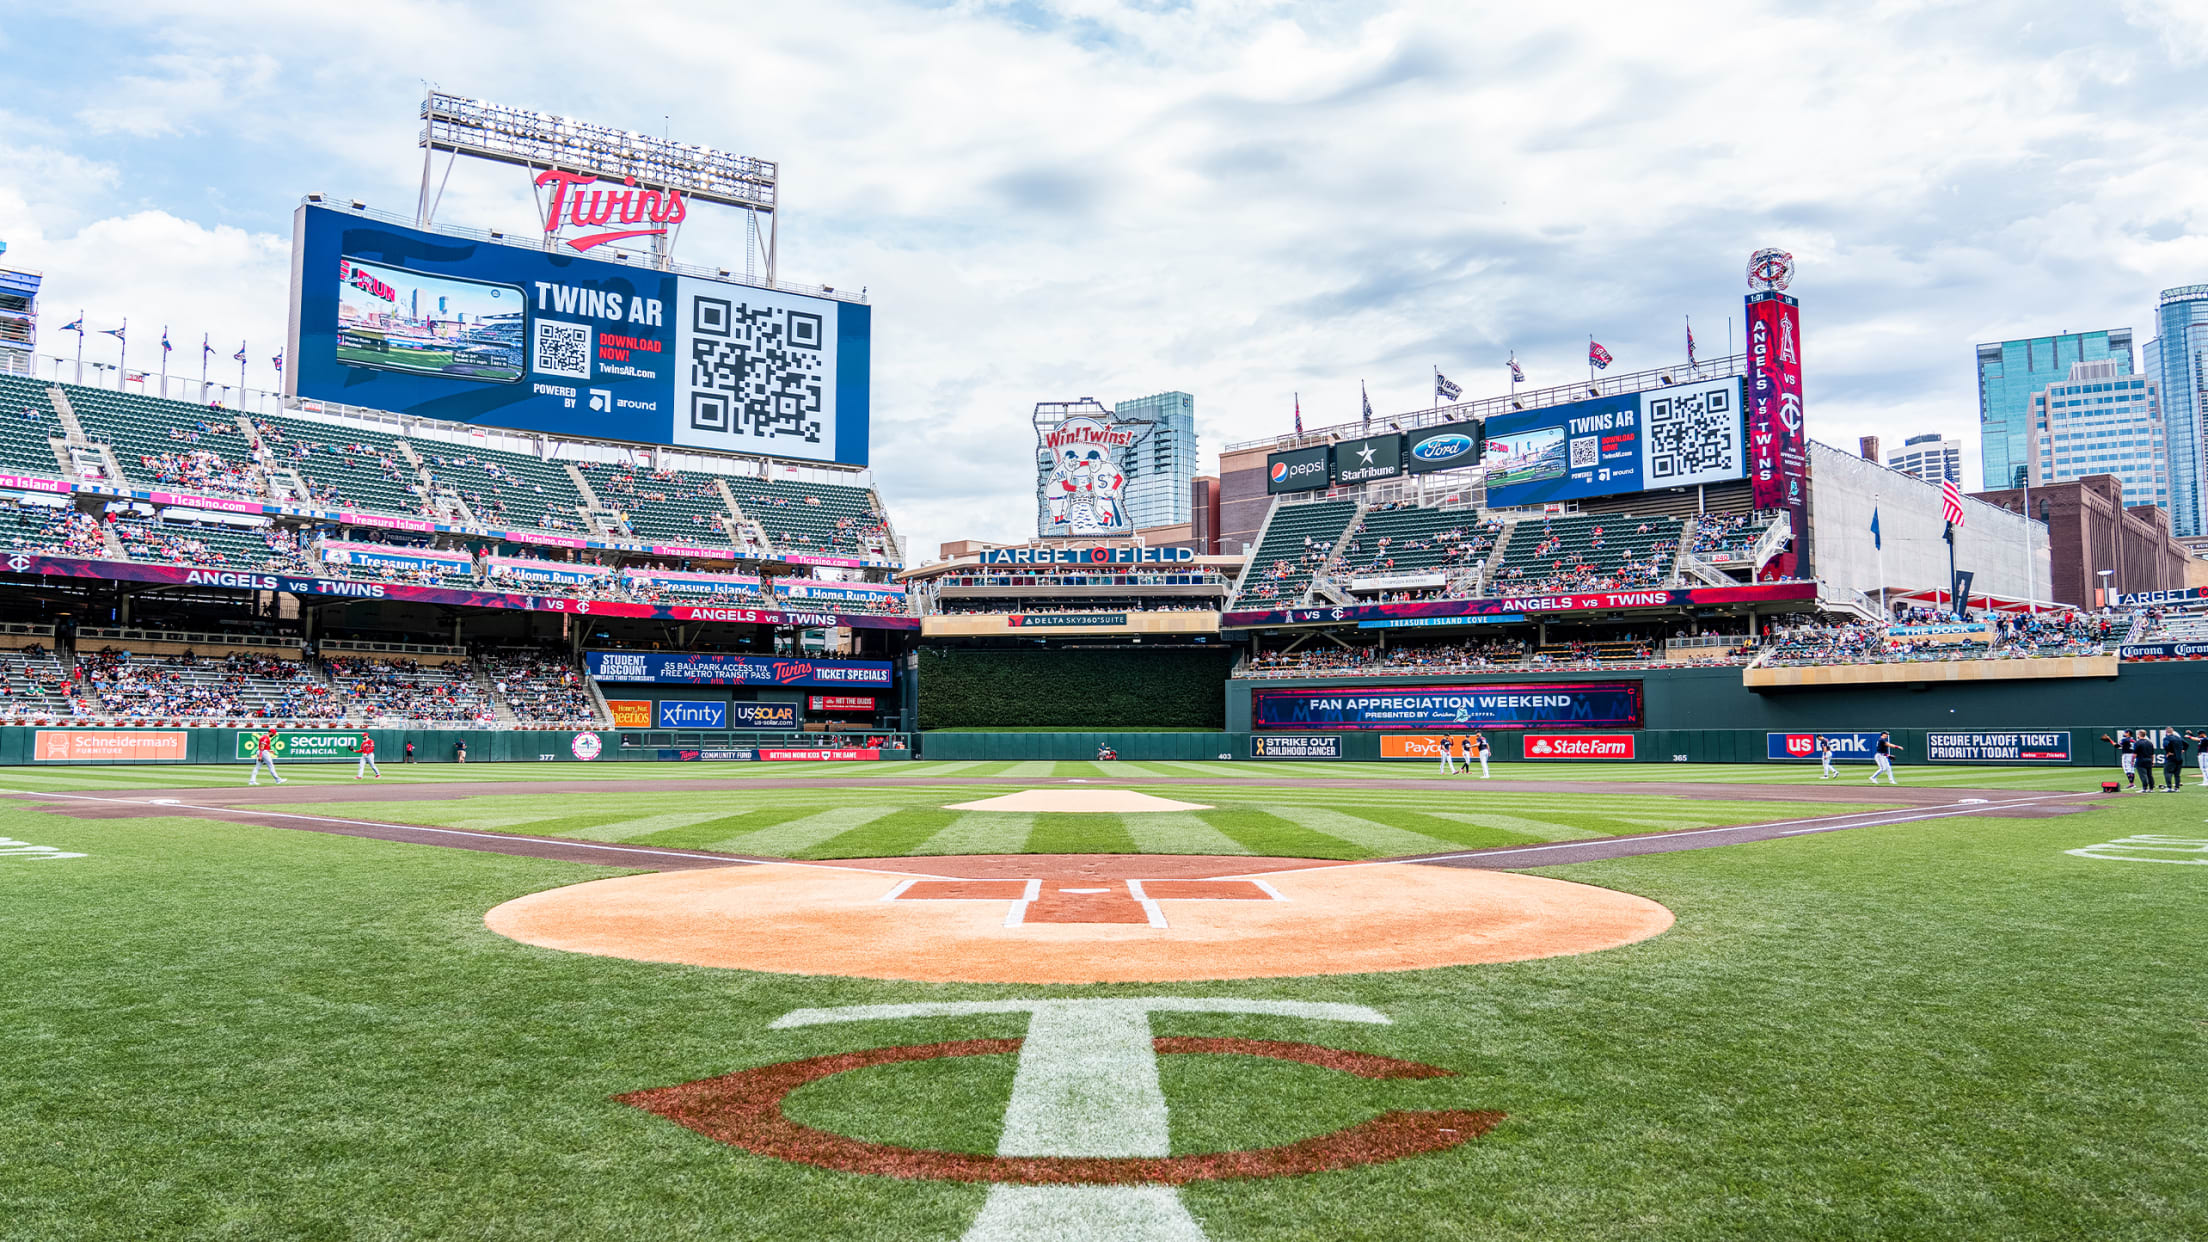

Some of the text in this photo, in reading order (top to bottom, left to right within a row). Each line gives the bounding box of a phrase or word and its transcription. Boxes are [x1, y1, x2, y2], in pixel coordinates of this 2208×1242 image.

[535, 169, 686, 233] Twins
[535, 281, 662, 327] TWINS AR
[599, 332, 662, 353] DOWNLOAD
[599, 346, 630, 362] NOW!
[1753, 320, 1767, 390] ANGELS
[599, 362, 656, 379] TwinsAR.com
[533, 383, 576, 397] POWERED
[564, 397, 576, 408] BY
[616, 398, 656, 411] around
[1569, 410, 1634, 434] TWINS AR
[1046, 424, 1133, 448] Win! Twins!
[1424, 438, 1461, 457] Ford
[1755, 422, 1772, 480] TWINS
[1289, 458, 1325, 479] pepsi
[17, 477, 58, 491] Island
[350, 514, 426, 531] Treasure Island
[661, 546, 727, 559] Treasure Island
[982, 547, 1195, 564] TARGET FIELD
[185, 570, 278, 590] ANGELS
[317, 580, 385, 598] TWINS
[552, 572, 575, 584] Run
[812, 588, 844, 600] Home
[846, 590, 868, 601] Run
[1502, 597, 1573, 612] ANGELS
[1606, 592, 1667, 606] TWINS
[690, 608, 757, 621] ANGELS
[786, 612, 837, 625] TWINS
[1389, 615, 1488, 627] TREASURE ISLAND COVE
[1904, 625, 1970, 636] THE DOCK
[2122, 646, 2164, 658] Corona
[602, 654, 646, 666] STUDENT
[664, 661, 676, 670] $5
[677, 662, 721, 671] BALLPARK
[722, 664, 753, 672] ACCESS
[600, 664, 647, 676] DISCOUNT
[660, 669, 771, 679] FREE METRO TRANSIT PASS
[772, 661, 812, 681] Twins
[815, 668, 887, 681] TICKET SPECIALS
[1310, 695, 1571, 711] FAN APPRECIATION WEEKEND
[611, 709, 650, 723] heerios
[663, 703, 723, 725] xfinity
[75, 736, 178, 748] Schneiderman's
[290, 736, 357, 747] securian
[1266, 738, 1336, 747] STRIKE OUT
[1788, 738, 1811, 752] us
[1930, 735, 2060, 746] SECURE PLAYOFF TICKET
[680, 749, 699, 760] Twins
[700, 751, 752, 759] COMMUNITY FUND
[833, 751, 842, 759] THE
[1266, 747, 1336, 756] CHILDHOOD CANCER
[1672, 754, 1688, 762] 365
[1931, 747, 1979, 758] PRIORITY
[1981, 747, 2019, 758] TODAY!
